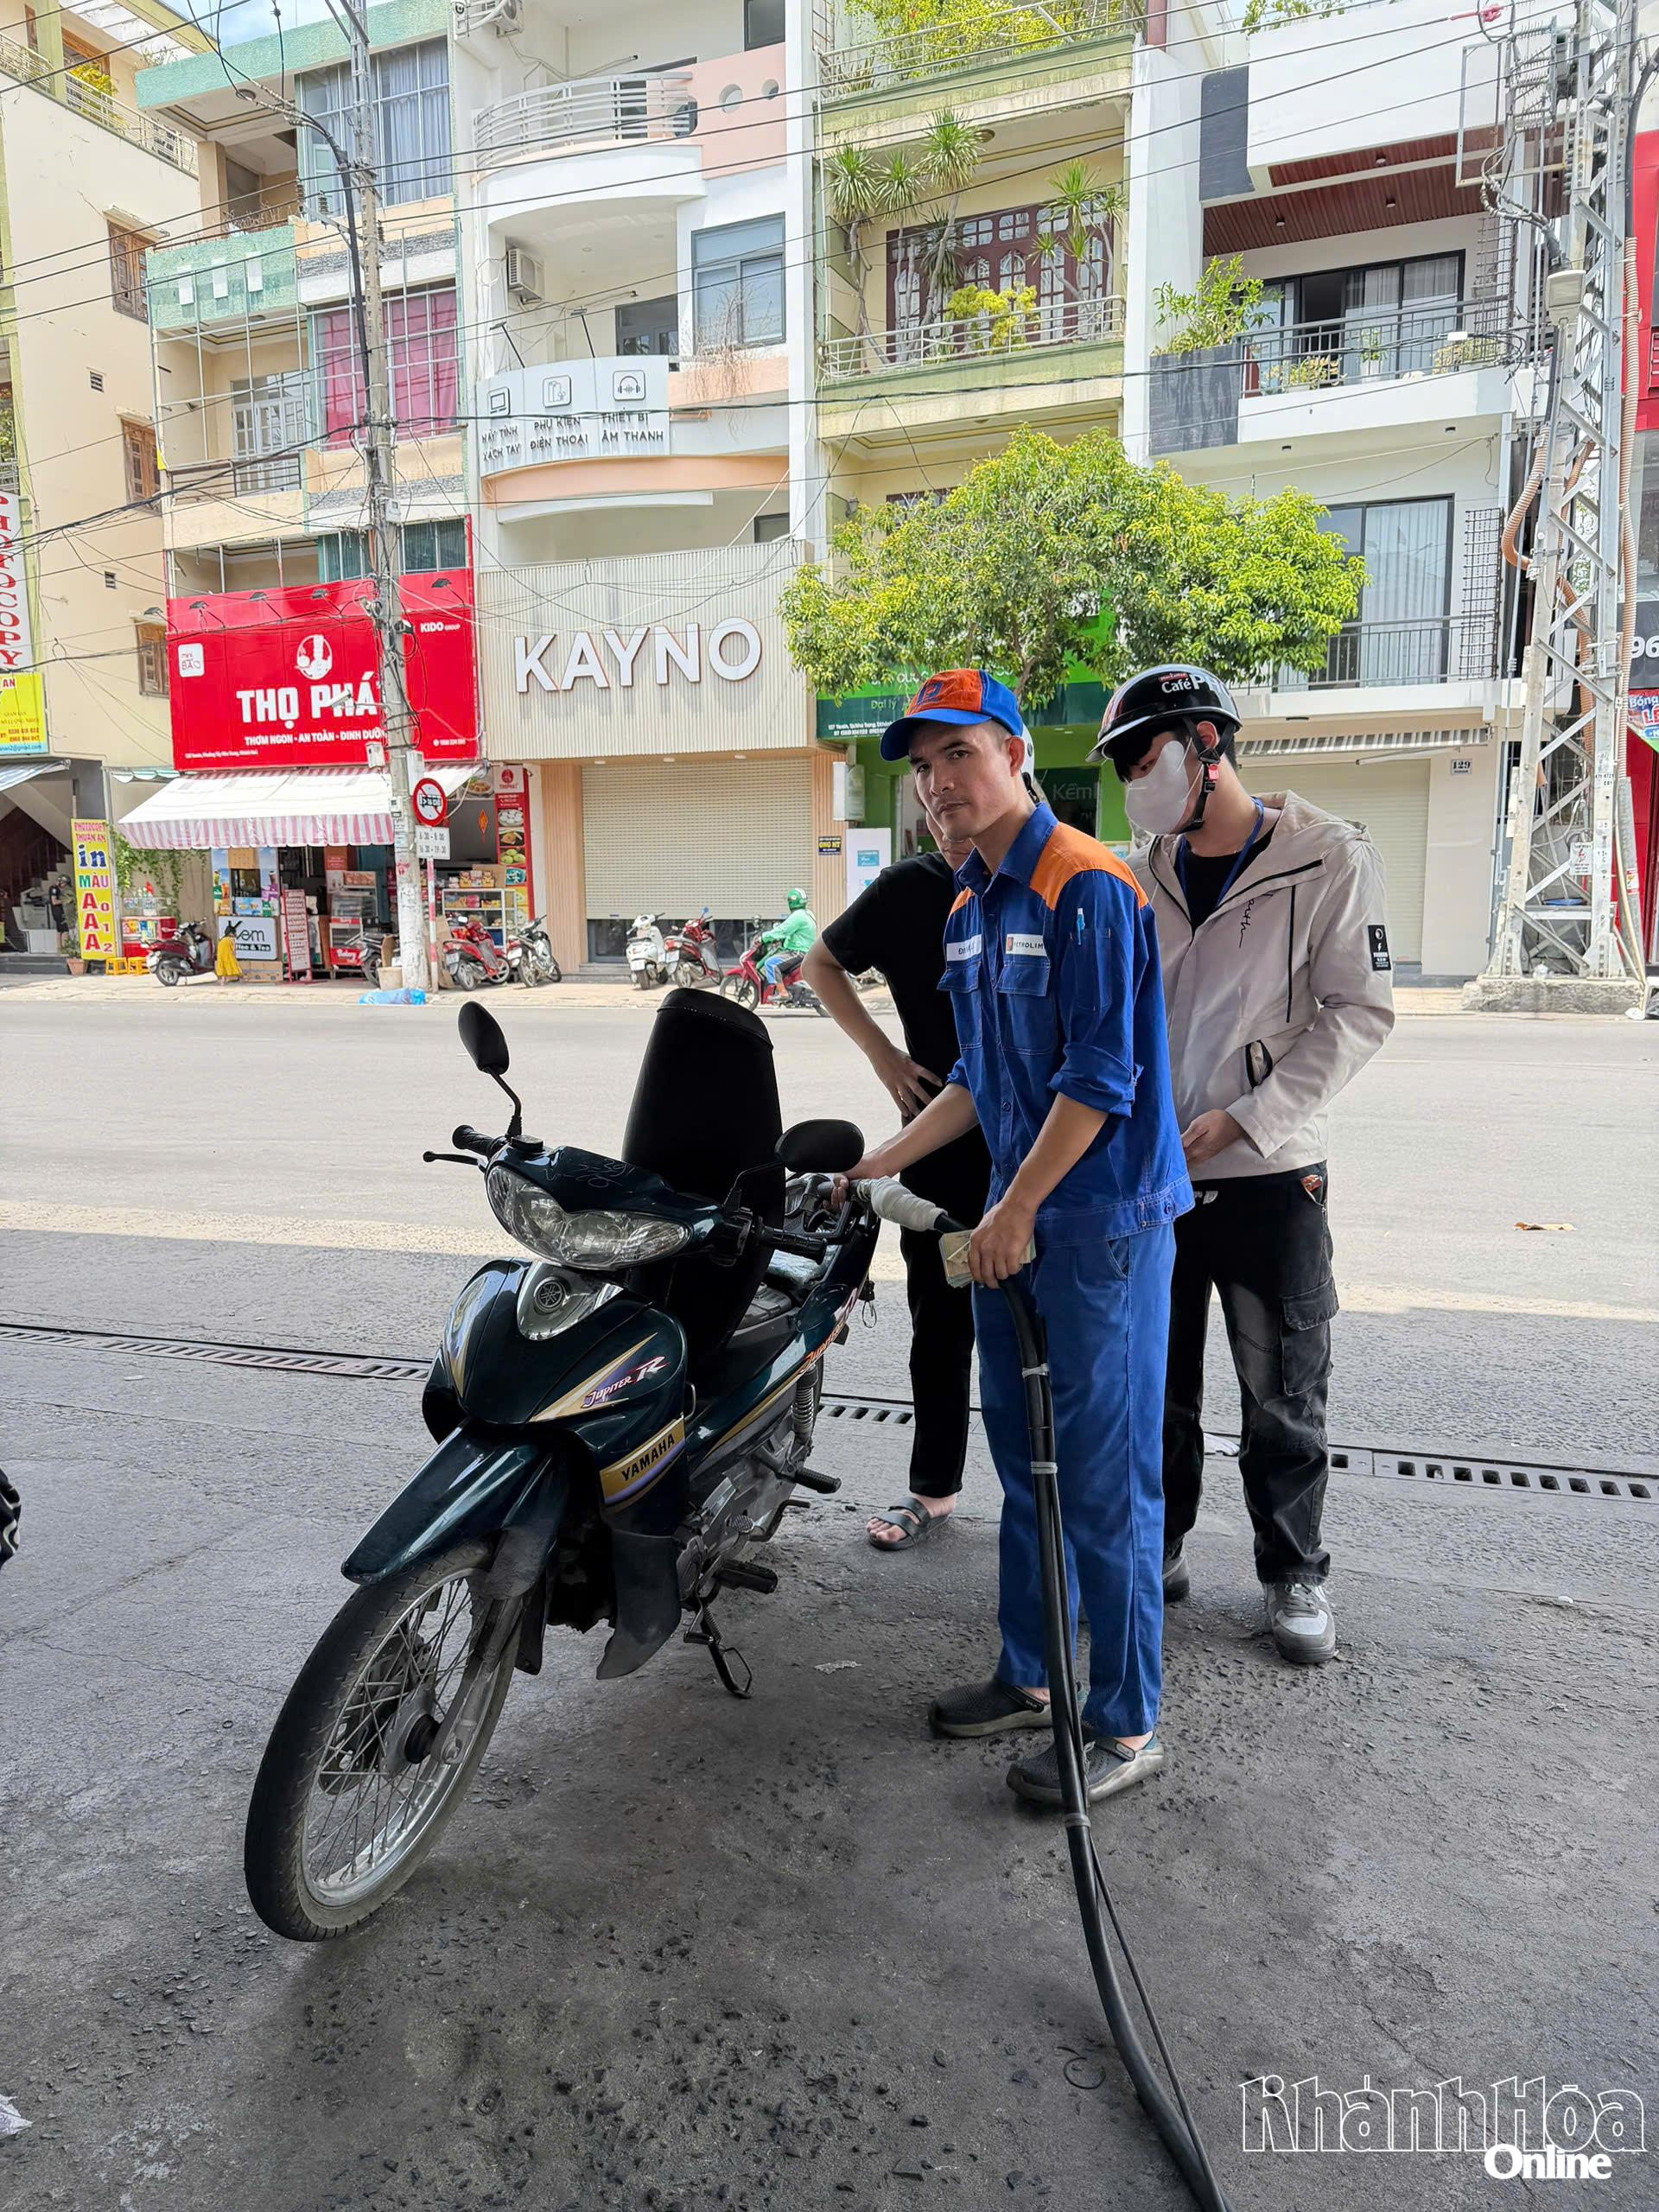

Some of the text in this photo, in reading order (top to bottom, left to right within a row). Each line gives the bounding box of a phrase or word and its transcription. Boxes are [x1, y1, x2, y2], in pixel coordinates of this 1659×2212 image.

[530, 433, 589, 450] ĐIỆN THOẠI
[601, 429, 664, 442] ÂM THANH
[505, 443, 520, 456] TAY
[420, 621, 444, 632] KIDO
[514, 616, 762, 694] KAYNO
[3, 677, 16, 688] AN
[1161, 678, 1192, 693] Café
[236, 671, 381, 729] THỌ PHÁ
[244, 735, 270, 747] THƠM
[270, 734, 294, 746] NGON
[298, 734, 311, 744] AN
[312, 728, 335, 743] TOÀN
[1452, 760, 1471, 769] 129
[78, 844, 107, 868] in
[79, 872, 109, 888] MÀU
[621, 1433, 676, 1482] YAMAHA
